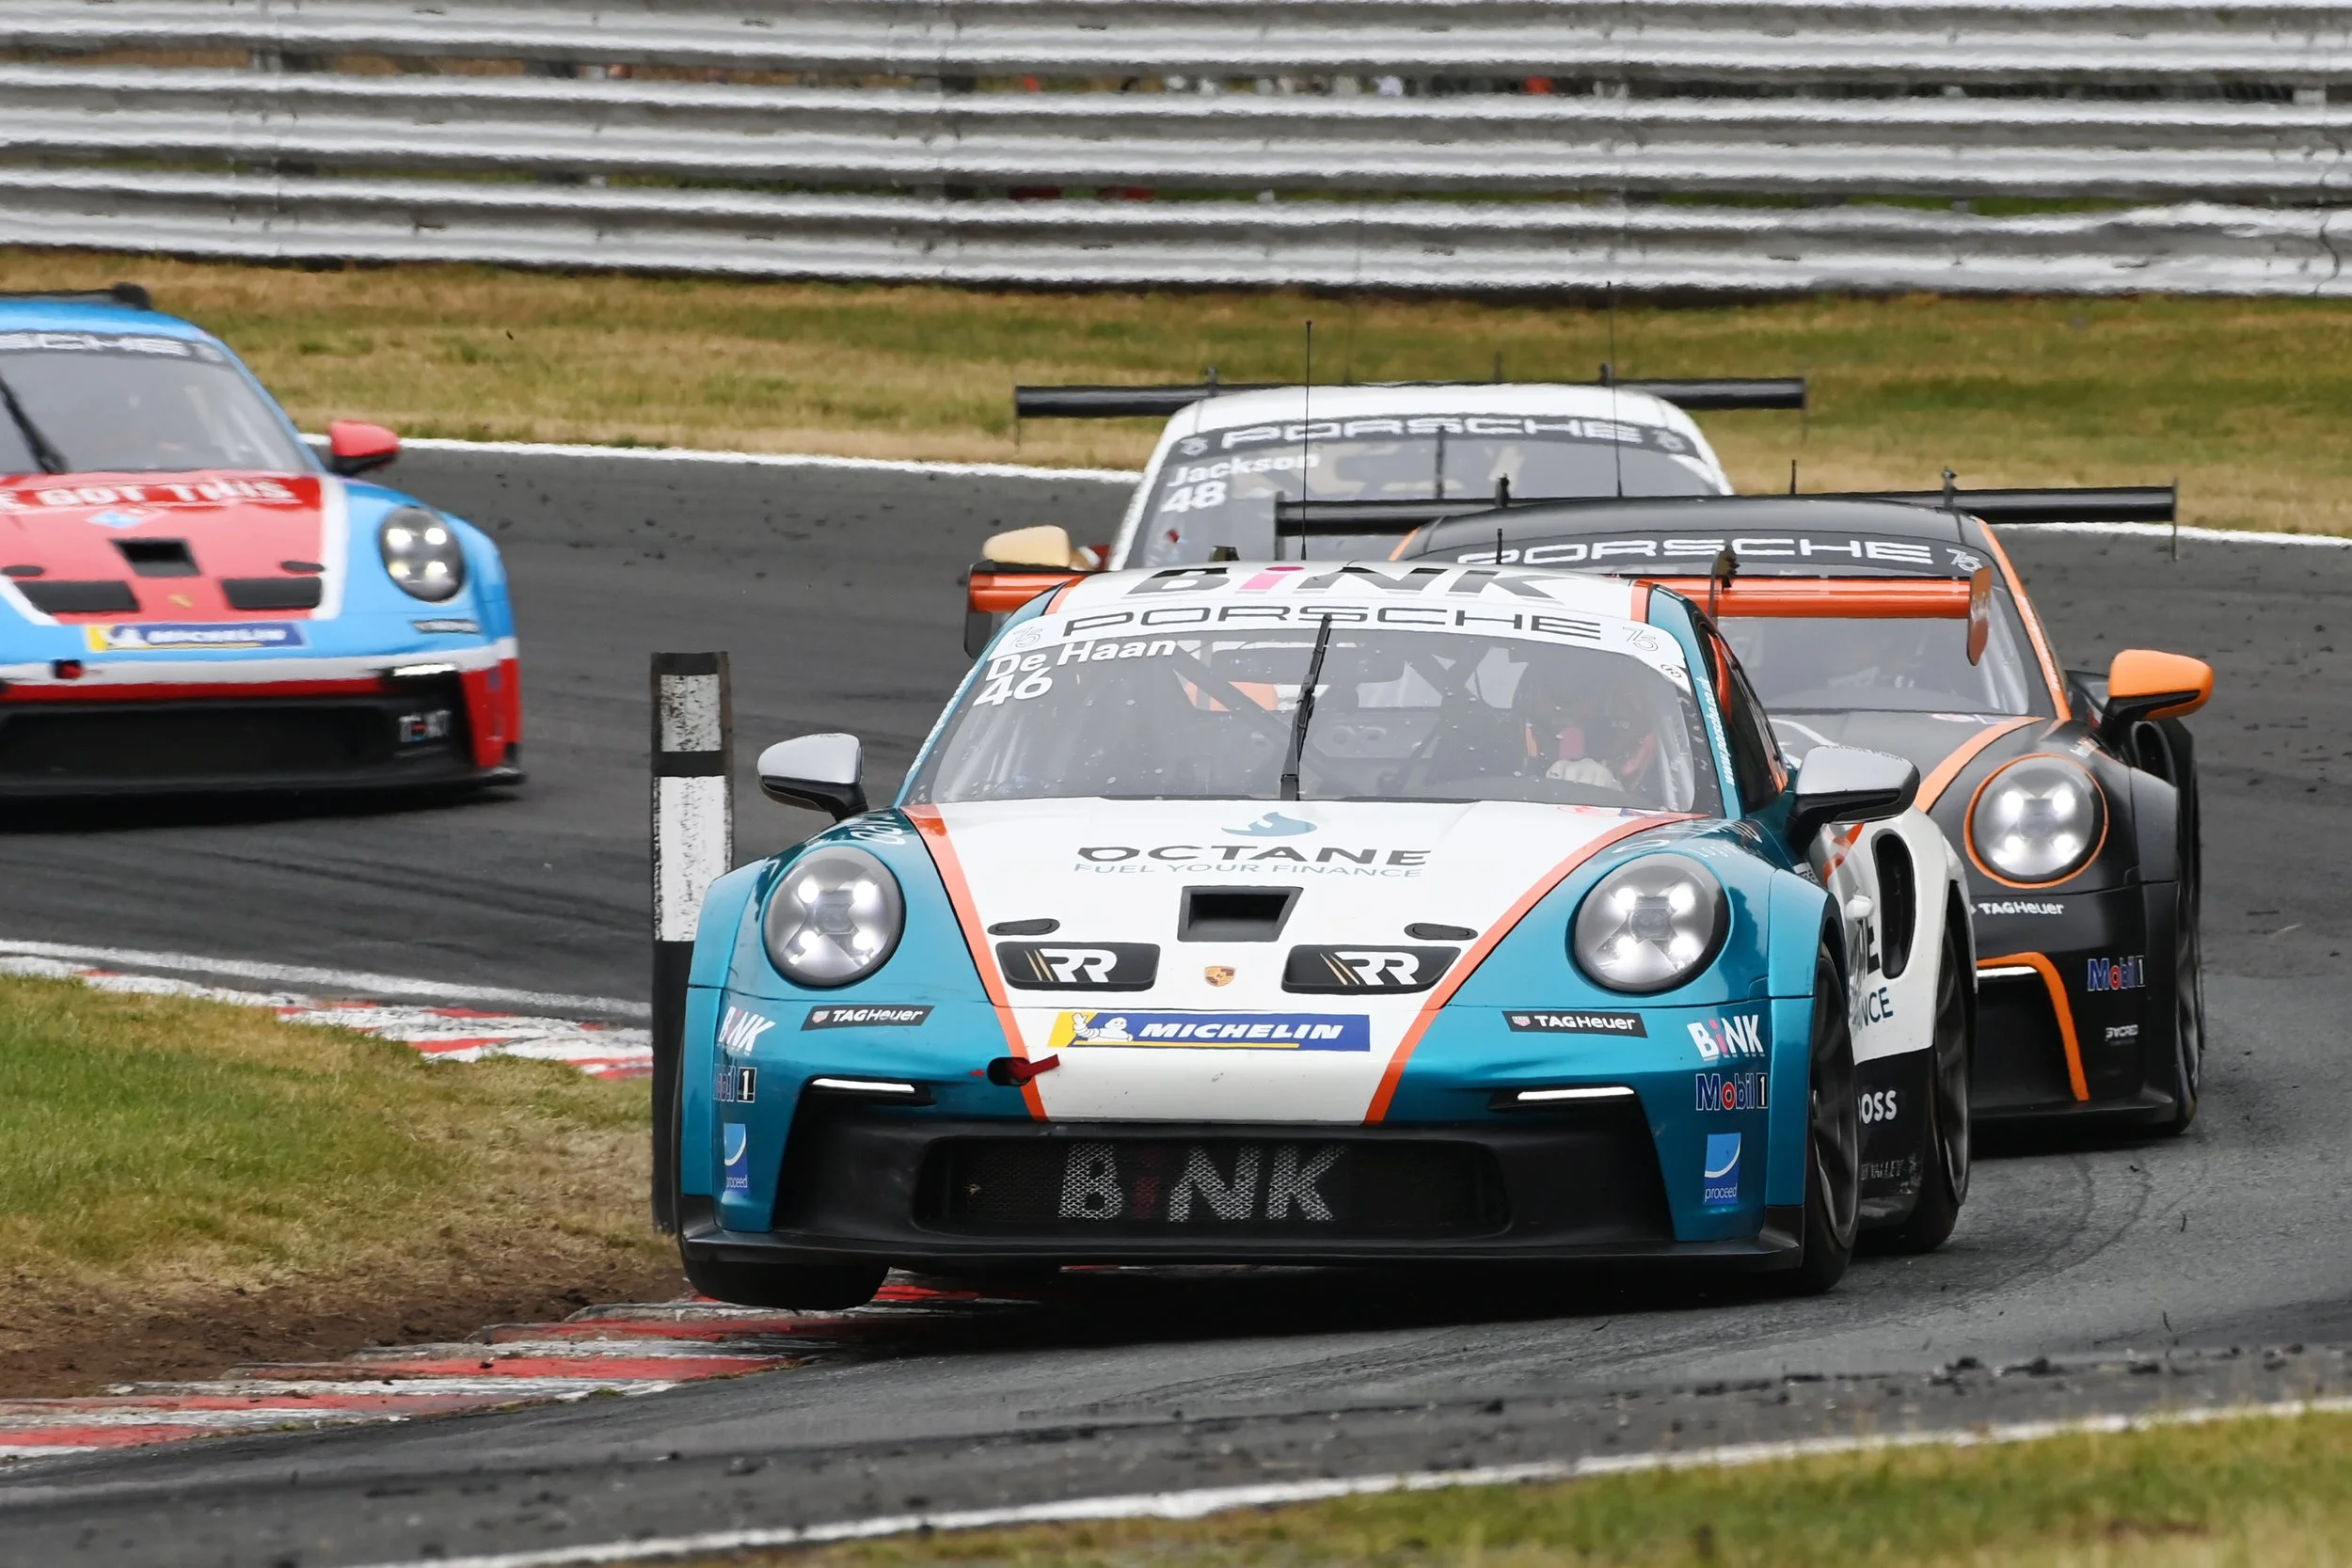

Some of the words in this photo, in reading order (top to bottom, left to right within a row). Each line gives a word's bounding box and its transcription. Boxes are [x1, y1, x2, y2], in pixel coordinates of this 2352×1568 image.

[1220, 418, 1644, 449] PORSCHE
[1168, 453, 1321, 487] Jackson
[36, 484, 149, 507] GOT
[155, 477, 296, 503] THIS
[1161, 480, 1227, 514] 48
[1457, 538, 1934, 564] PORSCHE
[1062, 605, 1601, 641] PORSCHE
[985, 656, 1047, 682] De
[1057, 640, 1177, 667] Haan
[973, 667, 1054, 707] 46
[1073, 863, 1154, 874] FUEL
[1168, 863, 1259, 874] YOUR
[1272, 863, 1423, 879] FINANCE
[1076, 845, 1432, 866] OCTANE
[1138, 1022, 1344, 1040] MICHELIN
[1695, 1072, 1755, 1112] Mobil
[1704, 1182, 1739, 1203] proceed
